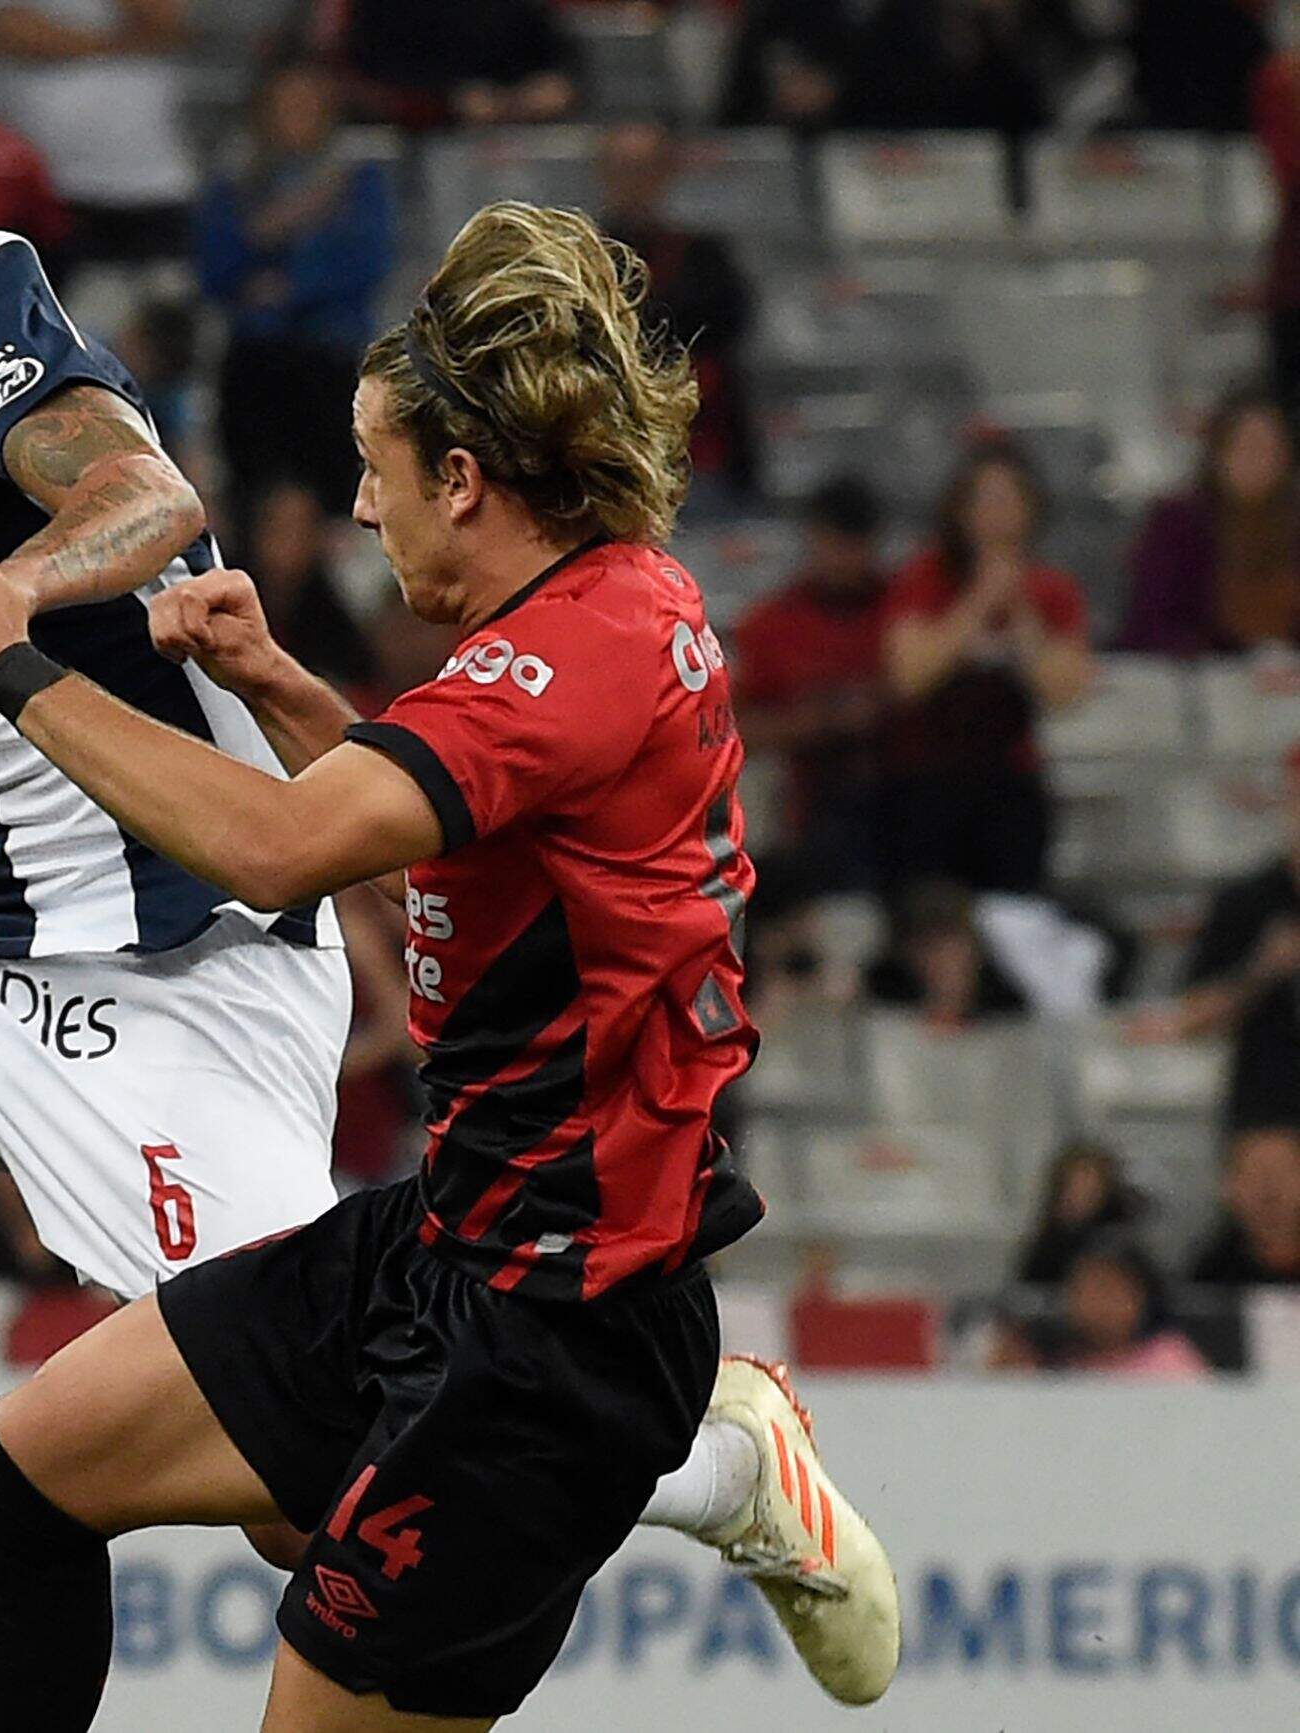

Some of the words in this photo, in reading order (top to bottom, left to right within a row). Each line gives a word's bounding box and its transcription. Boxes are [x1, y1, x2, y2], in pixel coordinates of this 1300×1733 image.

[140, 1143, 197, 1261] 6
[325, 1463, 436, 1582] 14
[553, 1564, 788, 1672] PA
[912, 1562, 1300, 1673] MERI
